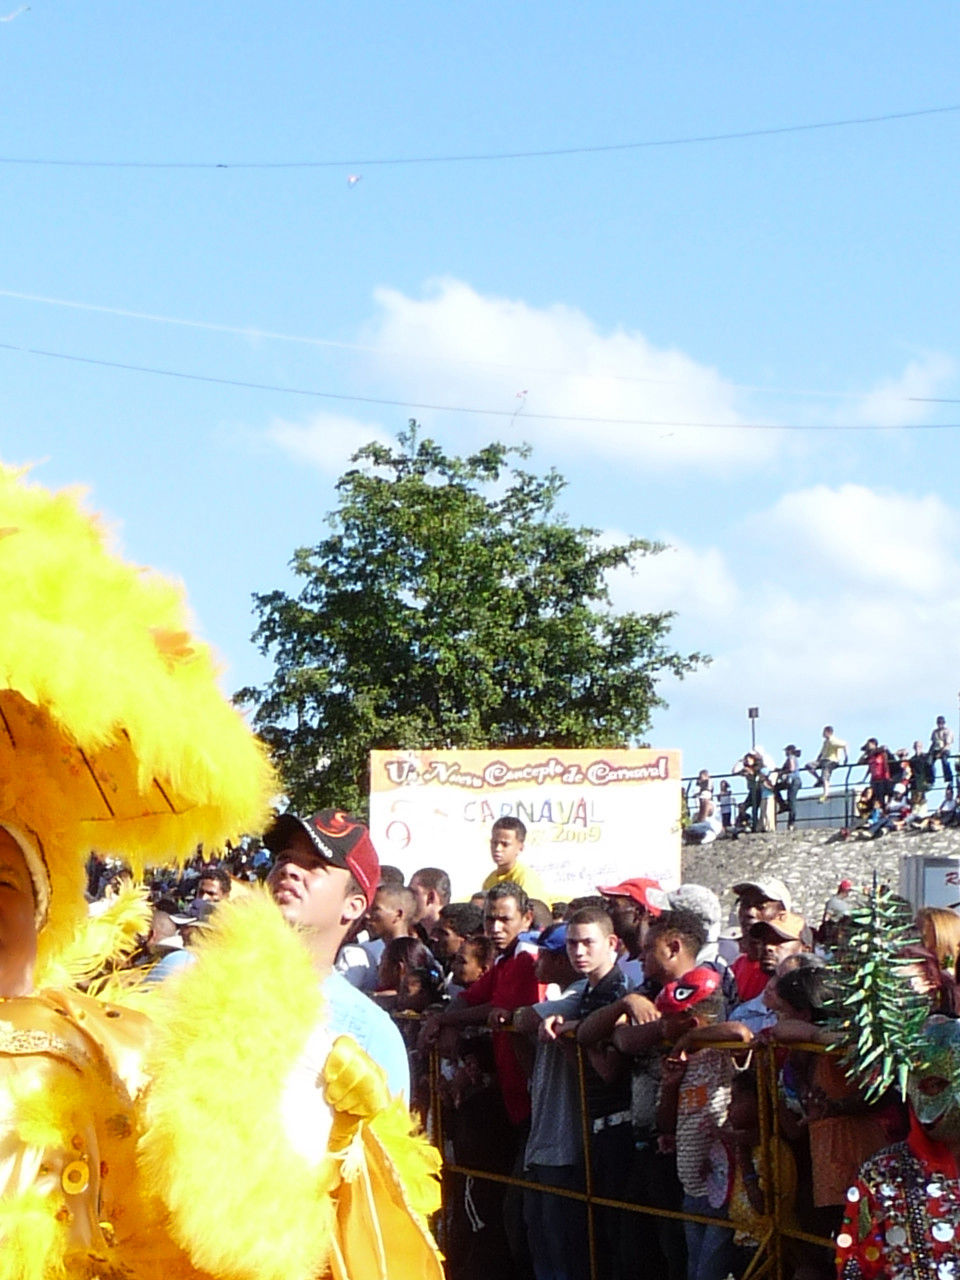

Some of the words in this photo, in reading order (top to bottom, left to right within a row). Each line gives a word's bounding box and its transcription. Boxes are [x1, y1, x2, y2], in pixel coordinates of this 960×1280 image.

[485, 757, 565, 786] Concepto
[562, 763, 585, 784] de
[587, 756, 669, 786] Carnaval
[463, 797, 605, 828] CARNAVAL
